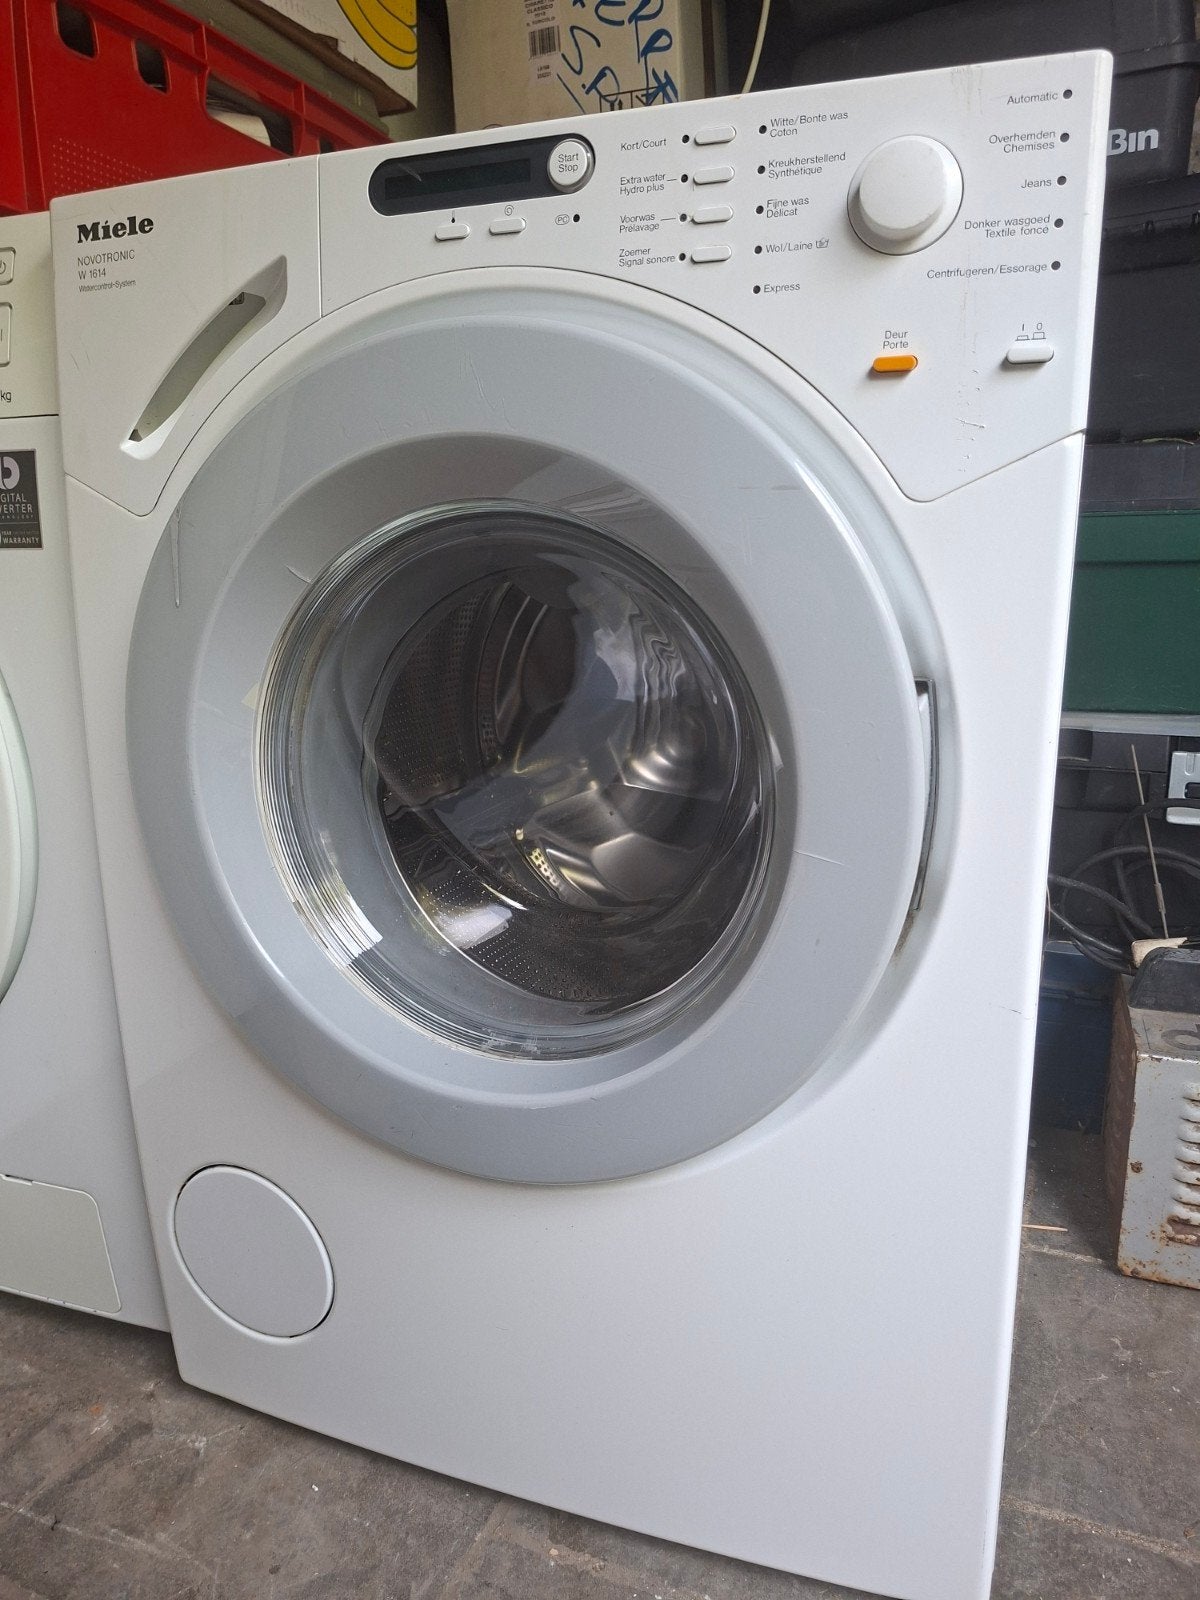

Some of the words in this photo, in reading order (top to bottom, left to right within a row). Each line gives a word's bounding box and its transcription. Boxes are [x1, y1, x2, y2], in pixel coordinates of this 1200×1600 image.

[1006, 92, 1058, 105] Automatic
[829, 112, 849, 120] was
[770, 128, 798, 138] Coton
[988, 131, 1056, 144] Overhemden
[620, 138, 667, 151] Kort/Court
[1003, 141, 1055, 153] Chemises
[1106, 129, 1159, 156] Bin
[558, 153, 579, 163] Start
[768, 152, 846, 168] Kreukherstellend
[558, 164, 579, 173] Stop
[768, 166, 823, 180] Synthétique
[620, 176, 642, 186] Extra
[643, 173, 666, 183] water
[1021, 179, 1052, 189] Jeans
[620, 186, 645, 196] Hydro
[646, 183, 665, 193] plus
[766, 199, 789, 209] Fijne
[790, 197, 810, 206] was
[620, 213, 656, 223] Voorwas
[766, 207, 798, 218] Délicat
[964, 218, 1001, 230] Donker
[1004, 214, 1051, 227] wasgoed
[77, 215, 154, 243] Miele
[985, 227, 1016, 238] Textile
[1021, 225, 1050, 236] foncé
[619, 247, 651, 258] Zoemer
[766, 241, 813, 253] Wol/Laine
[77, 249, 136, 267] NOVOTRONIC
[619, 256, 644, 267] Signal
[646, 255, 676, 265] sonore
[78, 270, 87, 280] W
[89, 268, 106, 279] 1614
[926, 263, 1048, 278] Centrifugeren/Essorage
[79, 280, 137, 293] Watercontrol-System
[763, 283, 801, 294] Express
[884, 330, 909, 340] Deur
[882, 340, 909, 350] Porte
[1, 389, 12, 402] kg
[2, 536, 40, 545] WARRANTY
